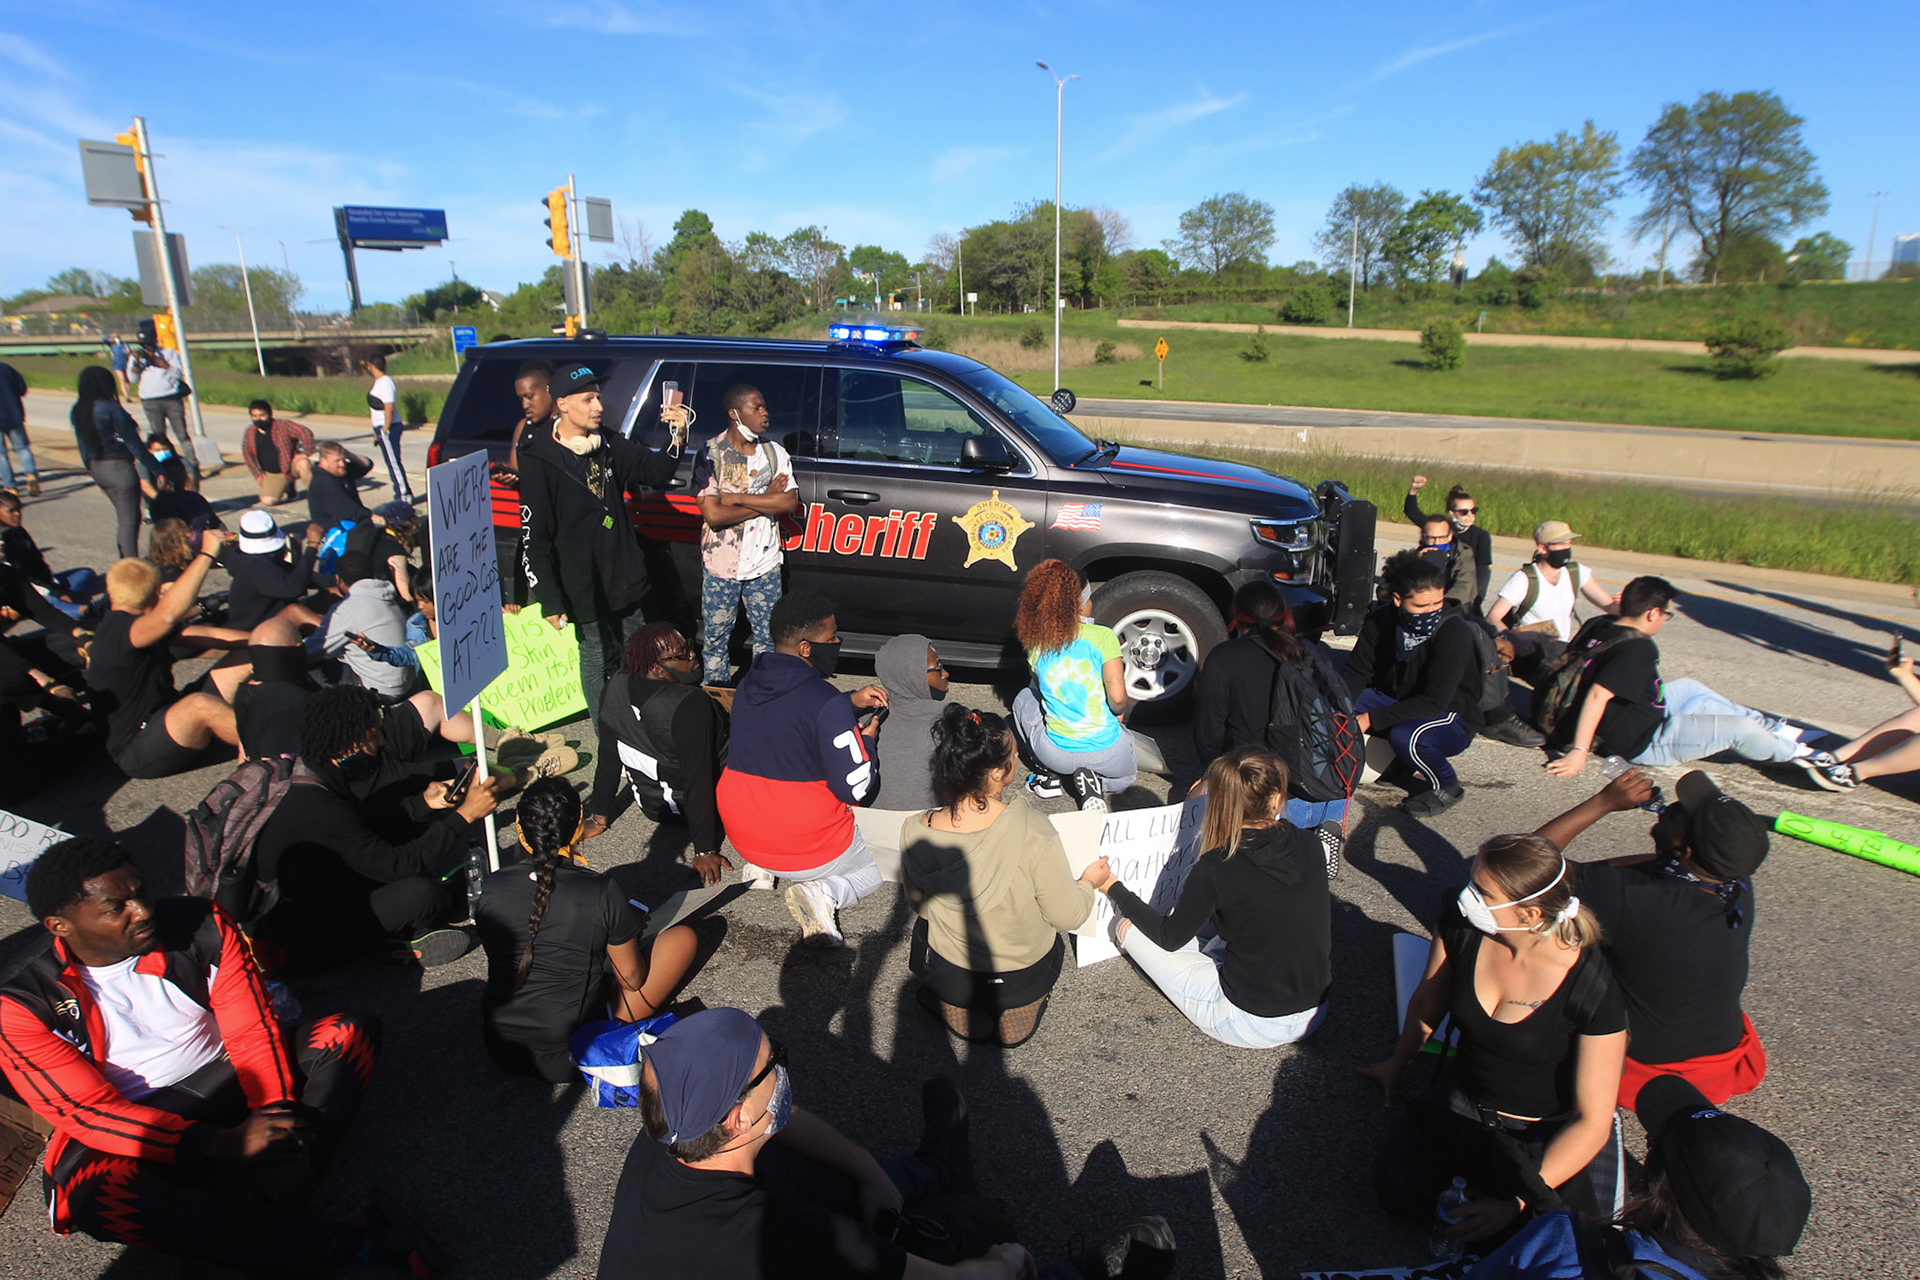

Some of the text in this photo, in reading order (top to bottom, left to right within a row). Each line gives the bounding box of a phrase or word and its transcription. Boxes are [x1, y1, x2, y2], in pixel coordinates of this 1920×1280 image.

[437, 460, 487, 530] WHERE
[976, 501, 1014, 512] SHERIFF
[985, 512, 1010, 525] COUNTY
[1000, 526, 1014, 553] SHERIFF
[438, 542, 460, 582] ARE
[469, 526, 489, 563] THE
[442, 570, 478, 626] GOOD
[512, 642, 557, 669] Skin
[1100, 804, 1199, 846] ALL LIVES
